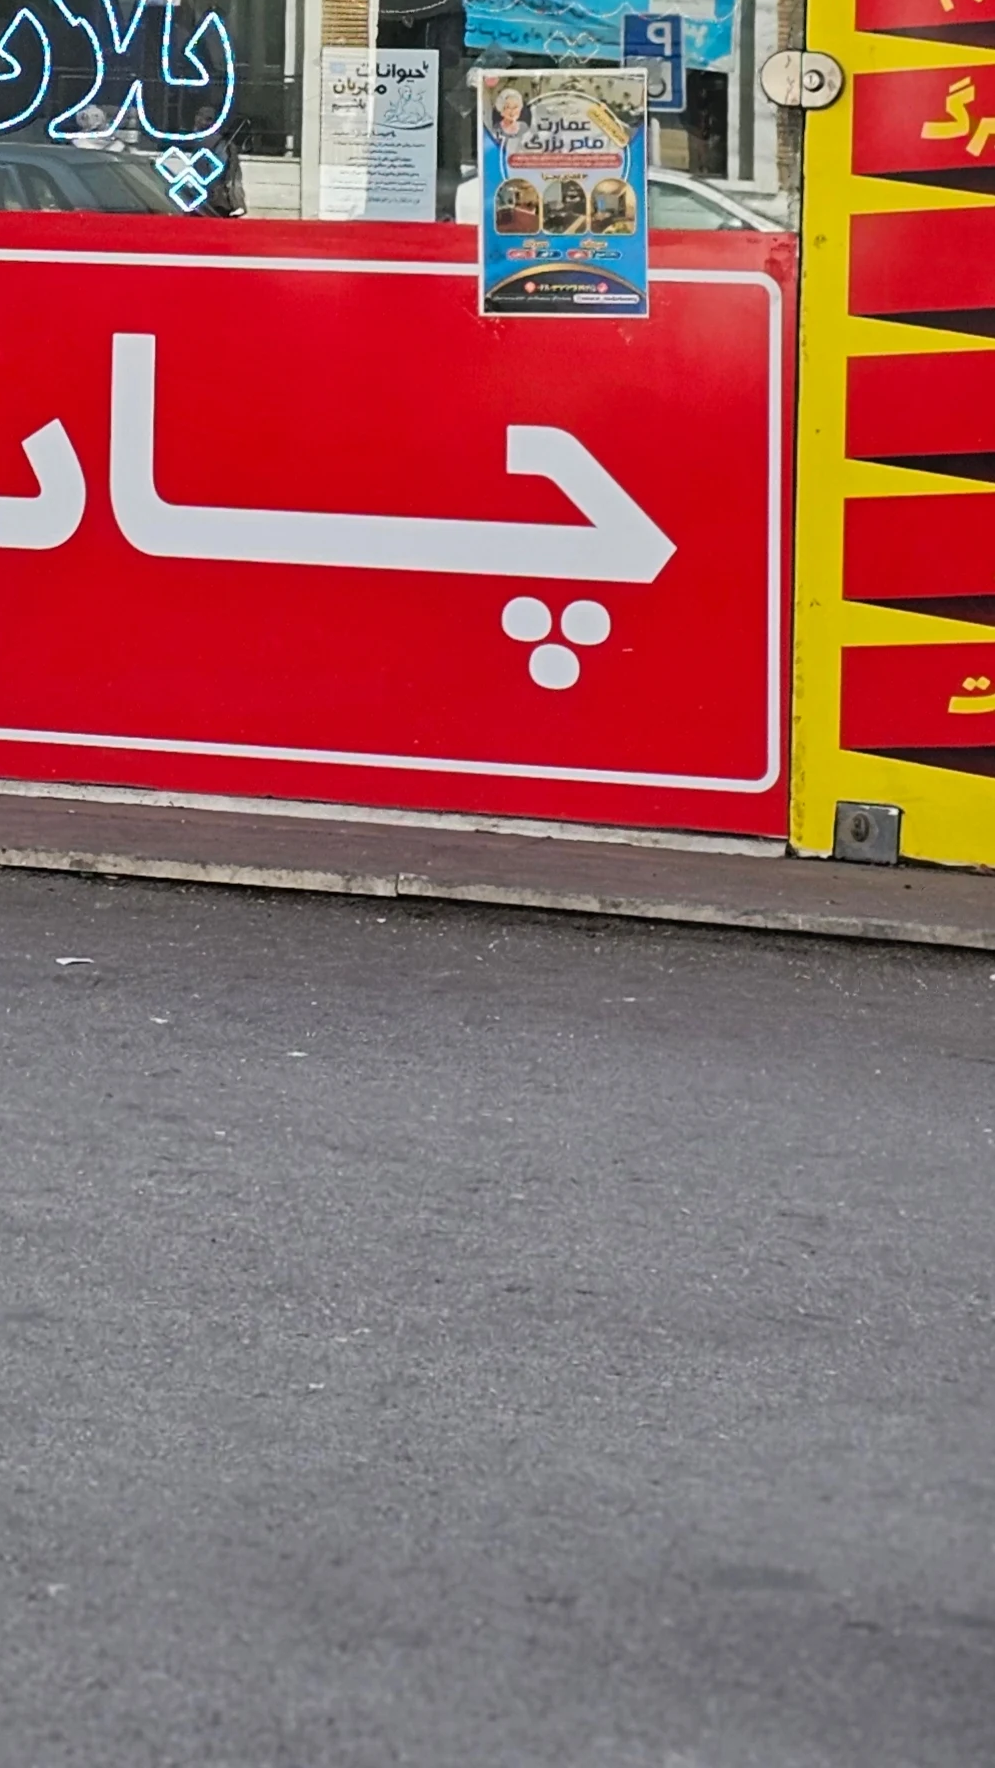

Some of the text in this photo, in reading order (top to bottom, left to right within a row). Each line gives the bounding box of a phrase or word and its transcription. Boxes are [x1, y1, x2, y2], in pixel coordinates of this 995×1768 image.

[356, 61, 426, 84] حیوانات
[537, 117, 591, 134] عمارت
[524, 133, 604, 153] مادر بزرگ
